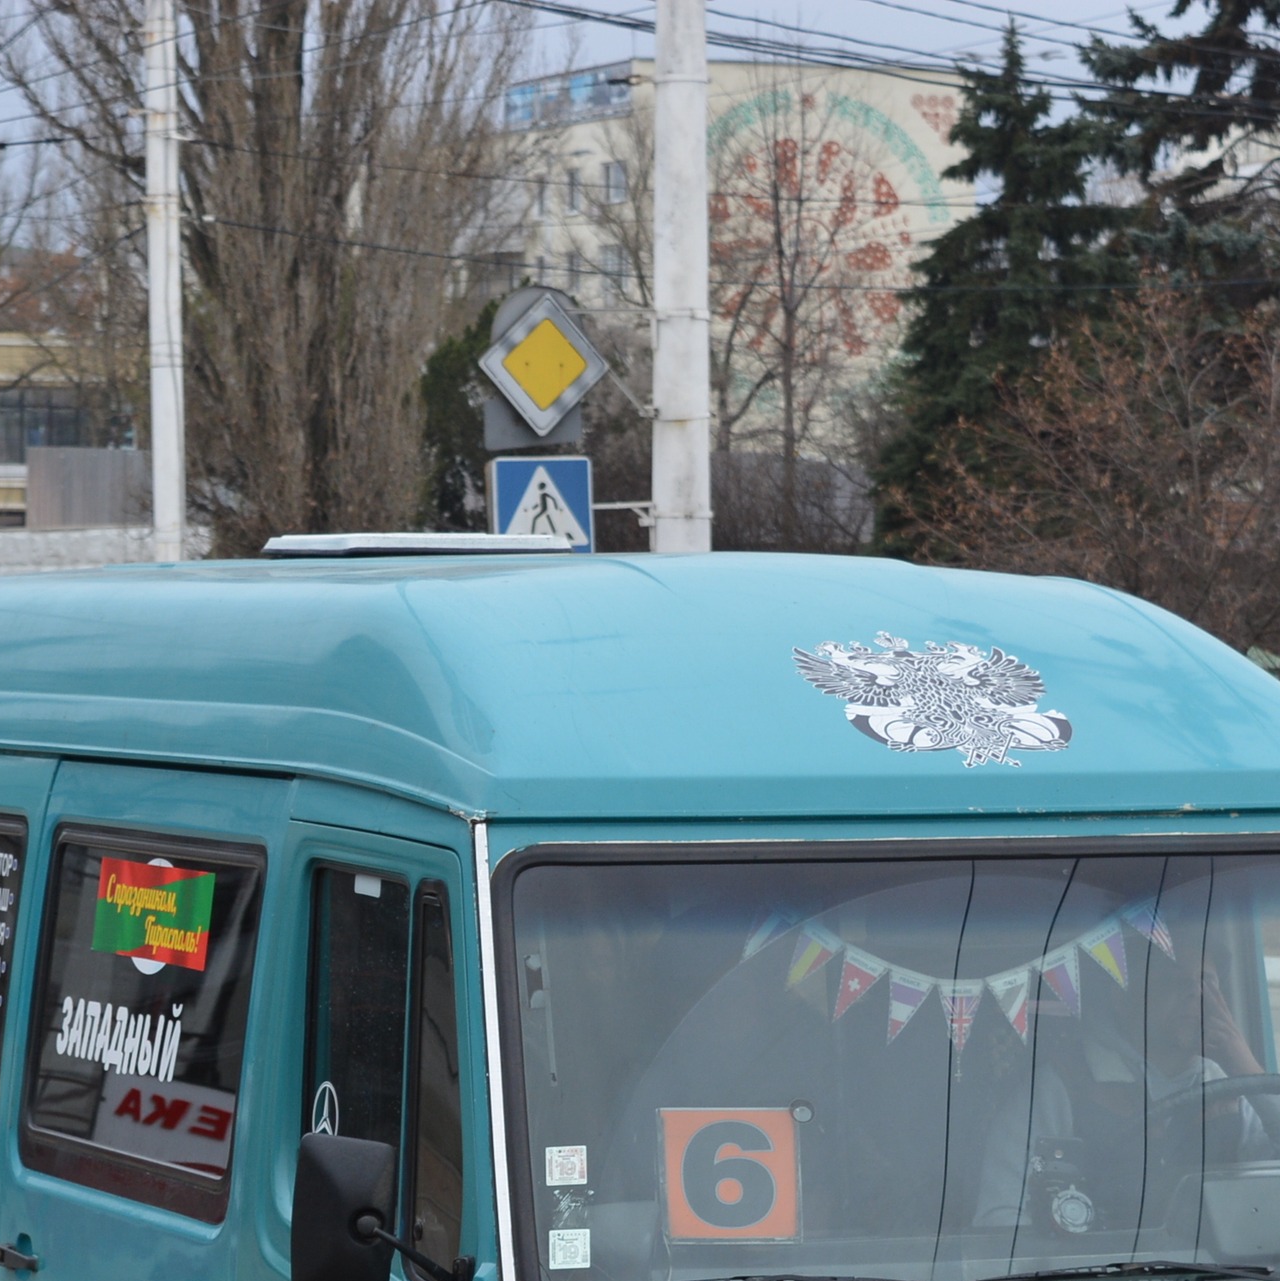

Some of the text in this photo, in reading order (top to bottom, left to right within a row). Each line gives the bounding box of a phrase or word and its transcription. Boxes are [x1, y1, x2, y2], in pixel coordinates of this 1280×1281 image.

[106, 873, 177, 917] С праздником,
[144, 914, 203, 955] Тирасполь!
[56, 996, 183, 1082] ЗАПАДНЫЙ
[681, 1119, 776, 1229] 6
